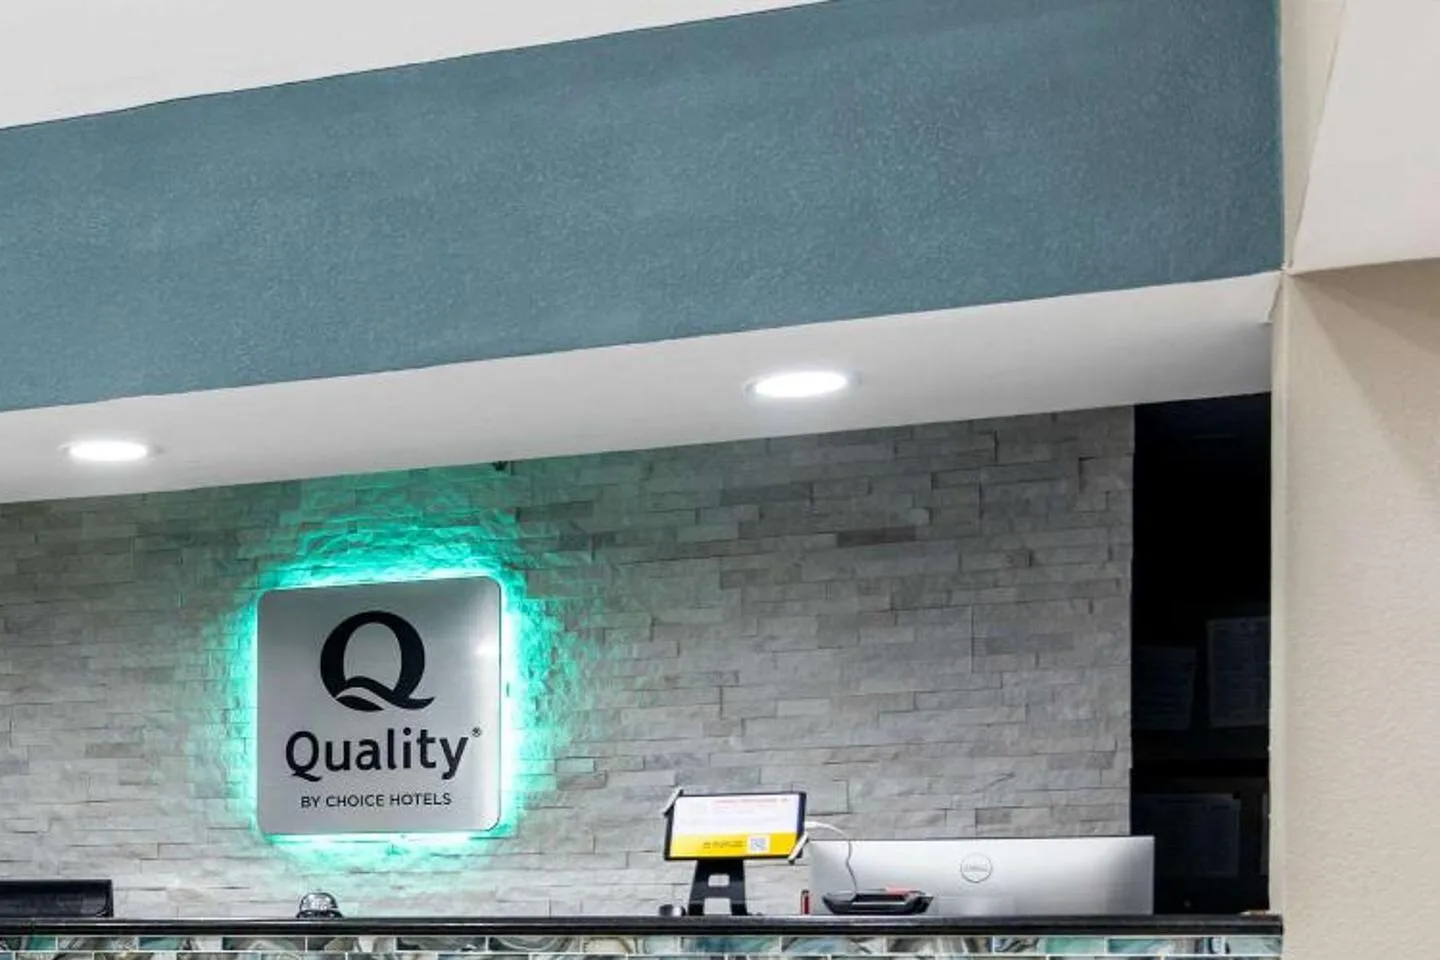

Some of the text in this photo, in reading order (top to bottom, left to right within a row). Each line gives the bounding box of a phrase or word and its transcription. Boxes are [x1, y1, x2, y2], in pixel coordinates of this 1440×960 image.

[300, 792, 453, 808] BY CHOICE HOTELS
